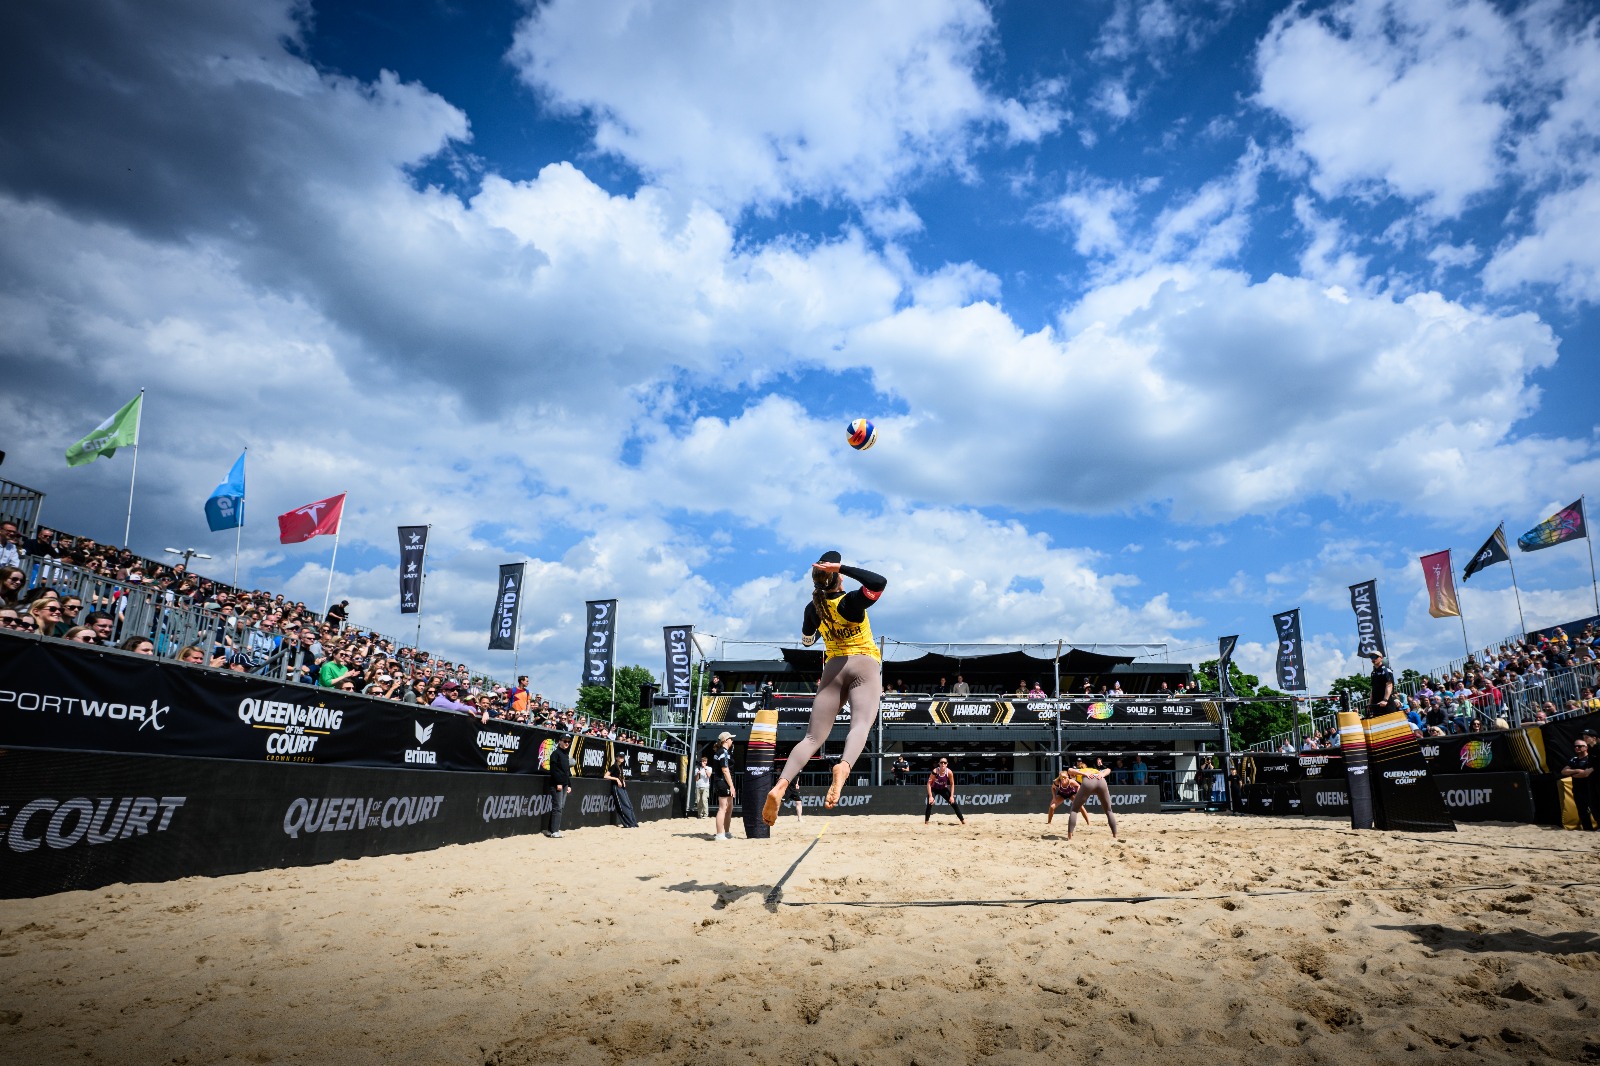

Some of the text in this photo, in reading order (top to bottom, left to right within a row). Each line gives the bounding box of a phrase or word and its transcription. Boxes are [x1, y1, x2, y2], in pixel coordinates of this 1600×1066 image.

[238, 698, 344, 730] QUEEN&KING
[737, 711, 757, 719] erim
[881, 702, 917, 712] EEN&KING
[953, 705, 991, 716] HAMBURG
[285, 725, 305, 735] OF THE
[266, 733, 319, 755] COURT
[404, 746, 437, 764] erima
[486, 752, 509, 766] COURT
[1383, 769, 1427, 779] QUEEN&KING
[581, 795, 605, 816] QUEEN
[836, 795, 873, 807] OURT
[972, 794, 1012, 806] COURT
[1316, 791, 1344, 807] QUEEN
[1446, 789, 1493, 807] COURT
[482, 795, 524, 823] QUEEN
[527, 794, 553, 817] COUR
[8, 797, 187, 852] COURT
[283, 795, 445, 839] QUEEN OF THE COURT
